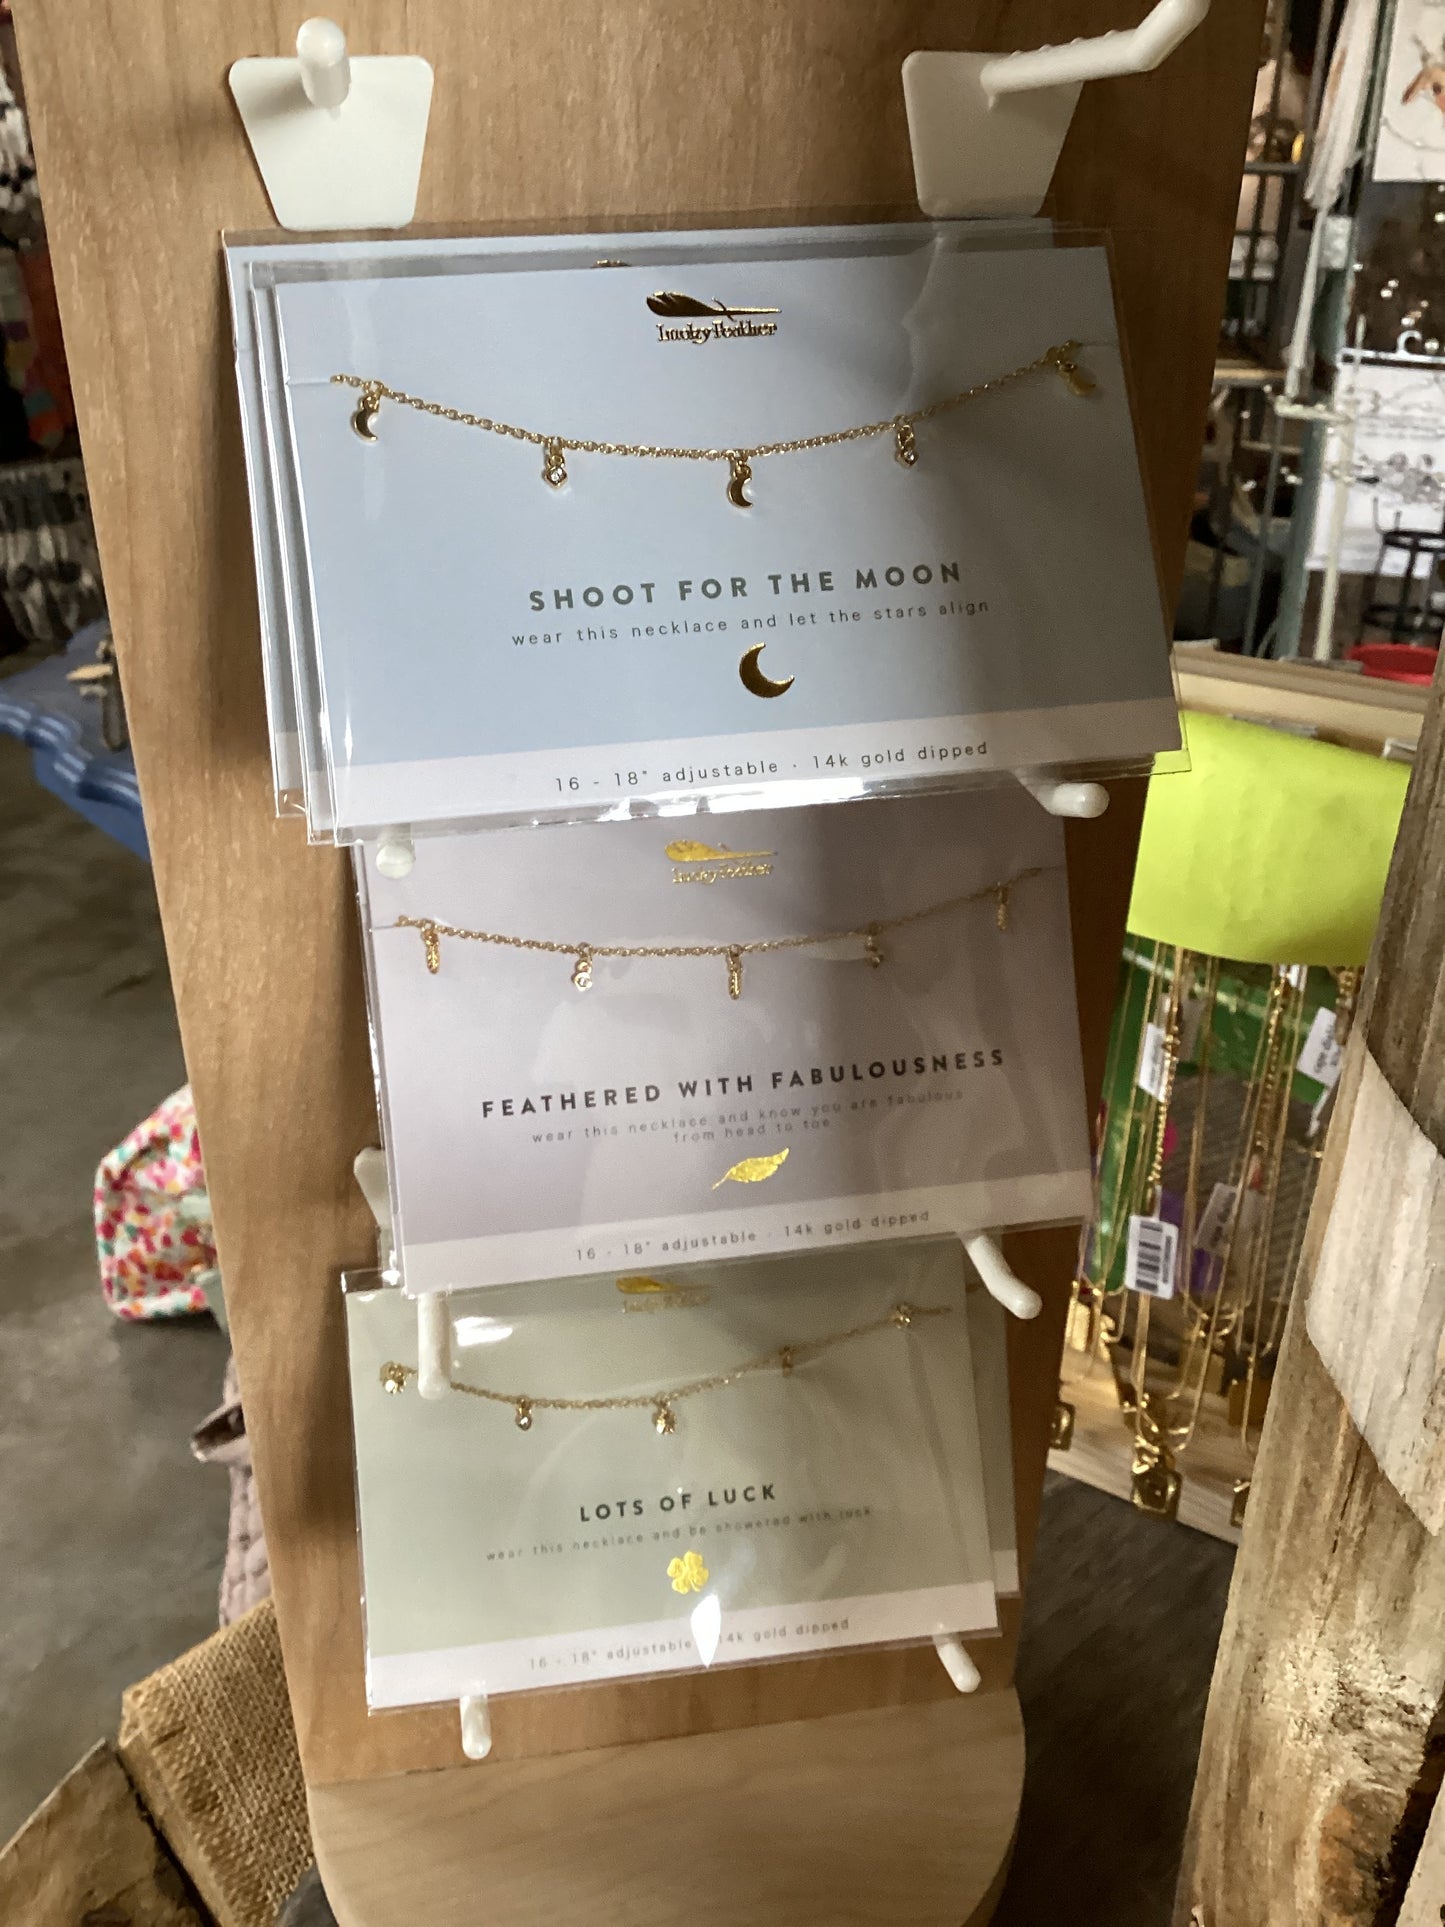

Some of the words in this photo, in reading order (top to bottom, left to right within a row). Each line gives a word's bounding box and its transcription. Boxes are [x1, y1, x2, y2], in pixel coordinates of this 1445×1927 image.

[529, 583, 655, 611] SHOOT
[678, 577, 748, 600] FOR
[768, 571, 834, 594] THE
[856, 562, 960, 588] MOON
[512, 631, 562, 646] wear
[577, 626, 618, 641] this
[632, 619, 727, 637] necklace
[741, 615, 776, 630] and
[789, 613, 817, 626] let
[830, 609, 861, 623] the
[874, 606, 927, 619] stars
[939, 600, 989, 616] align
[556, 777, 580, 792] 16
[615, 770, 648, 786] 18"
[662, 760, 778, 783] adjustable
[813, 753, 848, 769] 14k
[861, 749, 905, 767] gold
[918, 741, 988, 760] dipped
[482, 1083, 660, 1118] FEATHERED
[678, 1074, 752, 1098] WITH
[772, 1048, 1003, 1089] FABULOUSNESS
[532, 1130, 573, 1144] wear
[585, 1126, 618, 1139] this
[629, 1115, 708, 1134] necklace
[718, 1109, 748, 1125] and
[759, 1105, 800, 1120] know
[811, 1102, 842, 1116] you
[851, 1098, 877, 1111] are
[887, 1089, 964, 1107] fabulous
[673, 1129, 715, 1145] from
[725, 1121, 766, 1139] head
[777, 1118, 793, 1133] to
[803, 1116, 831, 1131] toe
[577, 1248, 597, 1261] 16
[662, 1231, 757, 1252] adjustable
[785, 1223, 812, 1237] 14k
[824, 1218, 861, 1235] gold
[871, 1210, 929, 1228] dipped
[579, 1498, 644, 1523] LOTS
[659, 1492, 692, 1512] OF
[708, 1482, 775, 1507] LUCK
[486, 1547, 523, 1562] wear
[533, 1542, 564, 1556] this
[573, 1532, 644, 1551] necklace
[653, 1527, 681, 1542] and
[689, 1523, 706, 1537] be
[716, 1515, 790, 1533] showered
[799, 1509, 831, 1524] with
[530, 1657, 549, 1671] 16
[607, 1638, 692, 1661] adjustable
[753, 1625, 787, 1642] gold
[796, 1618, 849, 1635] dipped
